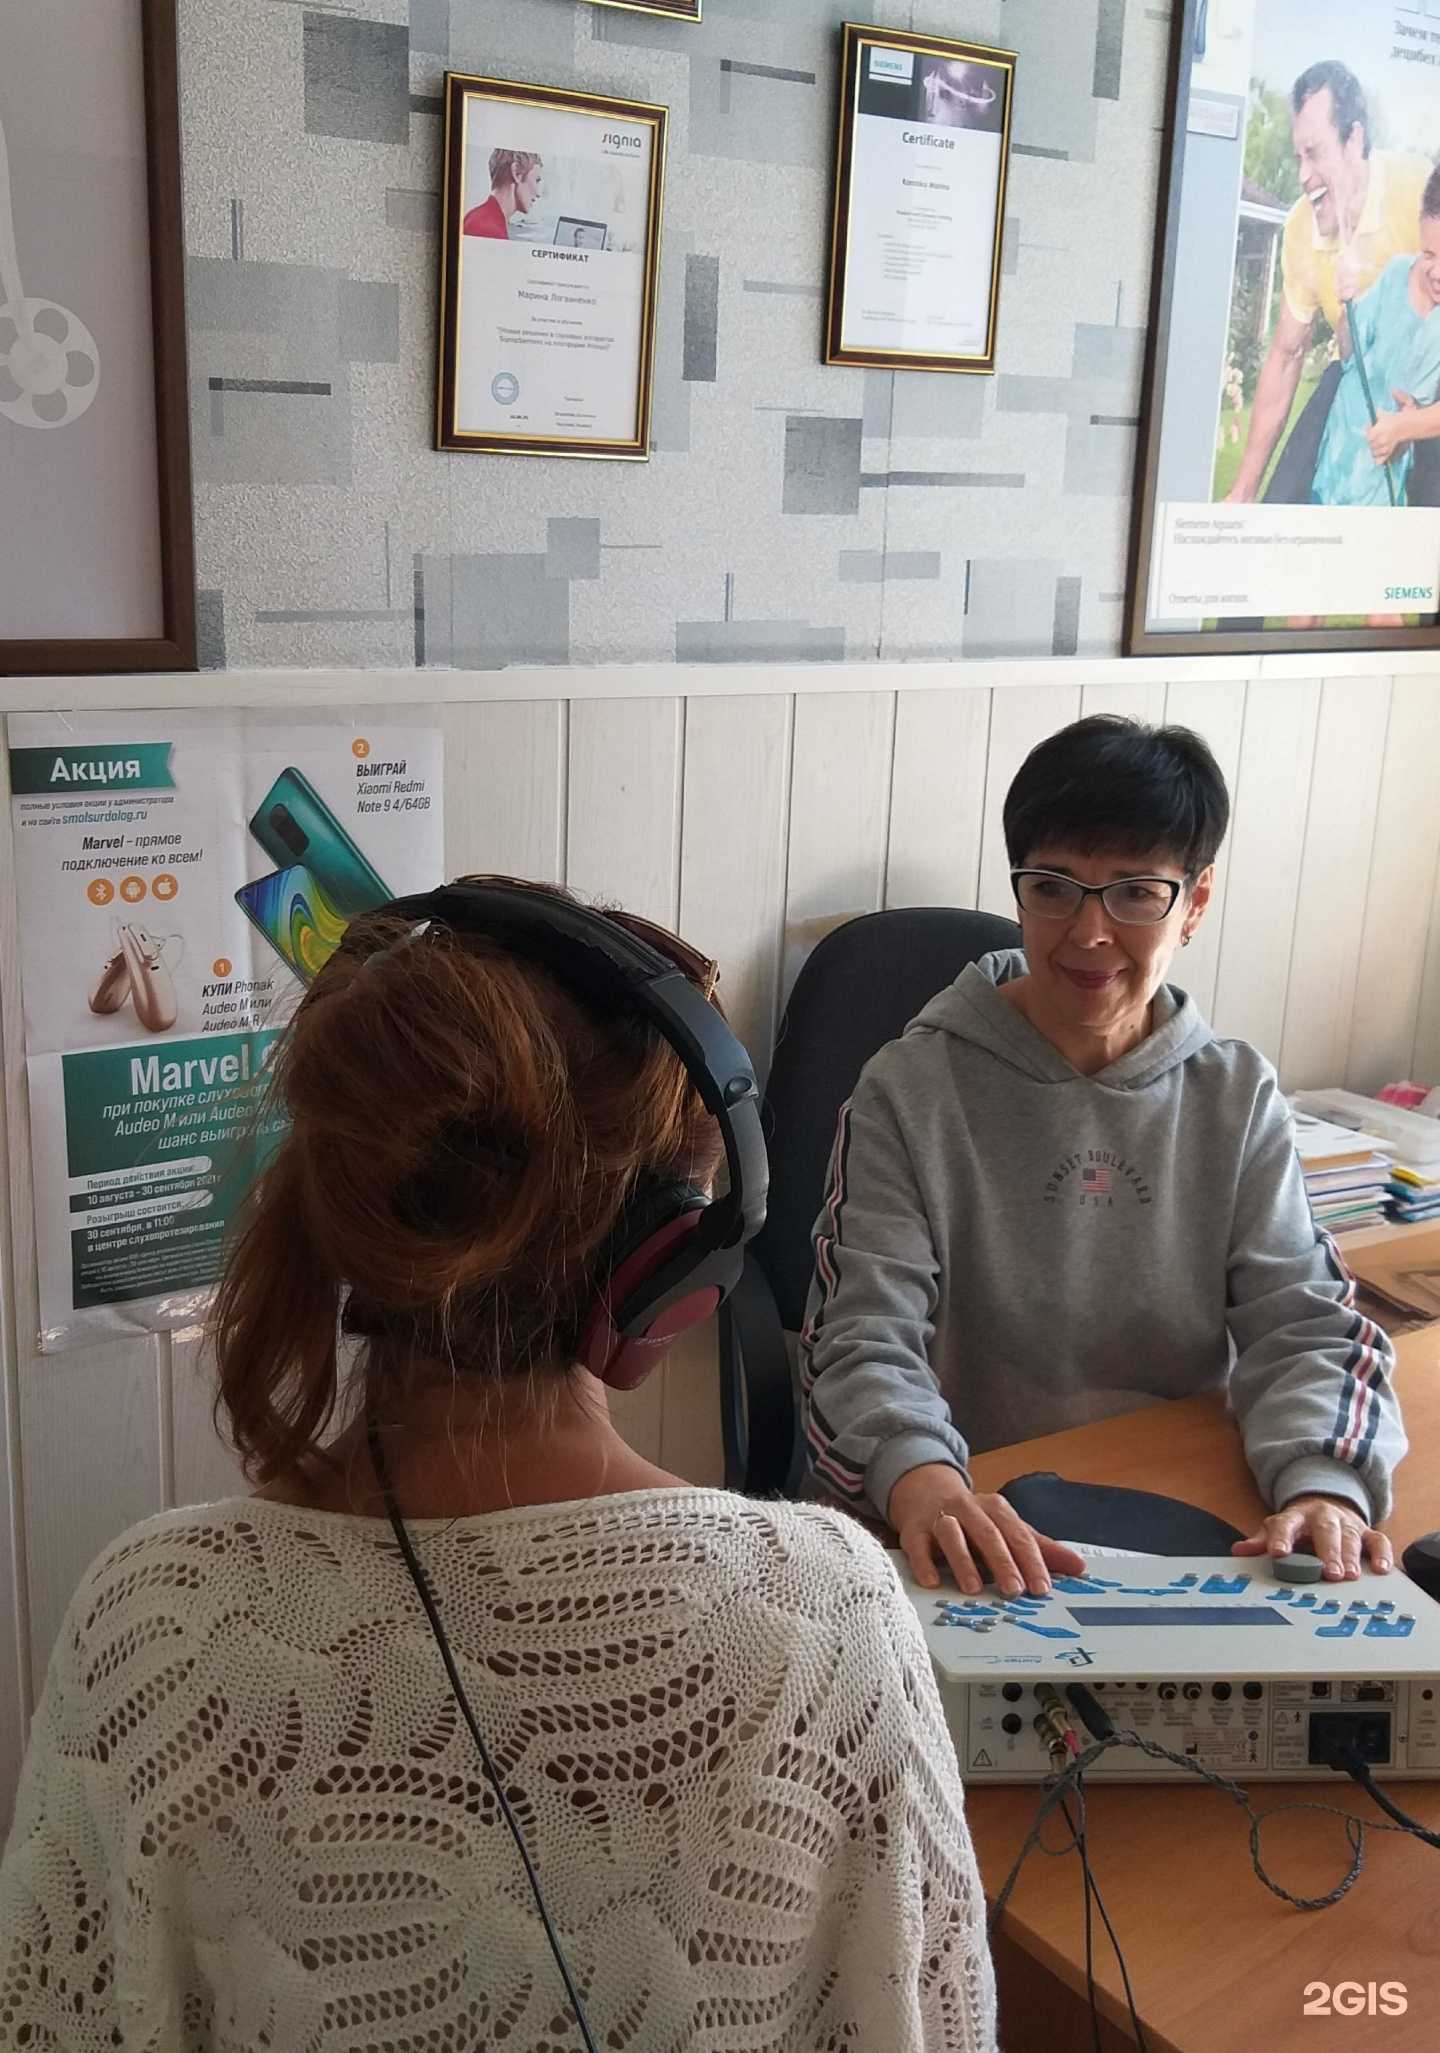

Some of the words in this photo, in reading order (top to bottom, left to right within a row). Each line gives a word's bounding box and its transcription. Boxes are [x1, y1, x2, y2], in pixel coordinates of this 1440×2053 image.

[602, 133, 641, 149] signia
[902, 131, 956, 150] Certificate
[531, 249, 590, 263] СЕРТИФИКАТ
[1384, 587, 1432, 600] SIEMENS
[357, 743, 365, 754] 2
[50, 757, 141, 783] Акция
[356, 760, 407, 777] ВЫИГРАЙ
[357, 781, 393, 795] Xiaomi
[394, 779, 425, 793] Redmi
[20, 802, 50, 811] полные
[52, 800, 83, 811] условия
[84, 800, 106, 809] акции
[357, 799, 382, 813] Note
[383, 799, 391, 812] 9
[393, 796, 431, 812] 4/64GB
[28, 819, 37, 827] на
[38, 818, 61, 827] сайте
[82, 835, 124, 850] Marvel
[135, 834, 182, 848] прямое
[62, 854, 149, 871] подключение
[151, 853, 165, 866] ко
[168, 848, 203, 864] всем!
[202, 982, 233, 998] КУПИ
[234, 978, 275, 994] Phonak
[202, 1001, 237, 1016] Audeo
[239, 997, 249, 1011] M
[249, 998, 273, 1009] или
[201, 1018, 238, 1033] Audeo
[130, 1043, 250, 1096] Marvel
[103, 1101, 131, 1121] при
[134, 1093, 195, 1115] покупке
[115, 1117, 160, 1138] Audeo
[163, 1112, 177, 1129] M
[178, 1110, 207, 1127] или
[158, 1133, 197, 1151] шанс
[87, 1177, 121, 1191] Период
[123, 1170, 166, 1185] действия
[87, 1194, 97, 1205] 10
[99, 1188, 134, 1204] августа
[142, 1184, 153, 1196] 30
[154, 1178, 195, 1194] сентября
[87, 1209, 136, 1226] Розыгрыш
[87, 1229, 98, 1241] 30
[88, 1244, 94, 1253] в
[95, 1237, 128, 1252] центре
